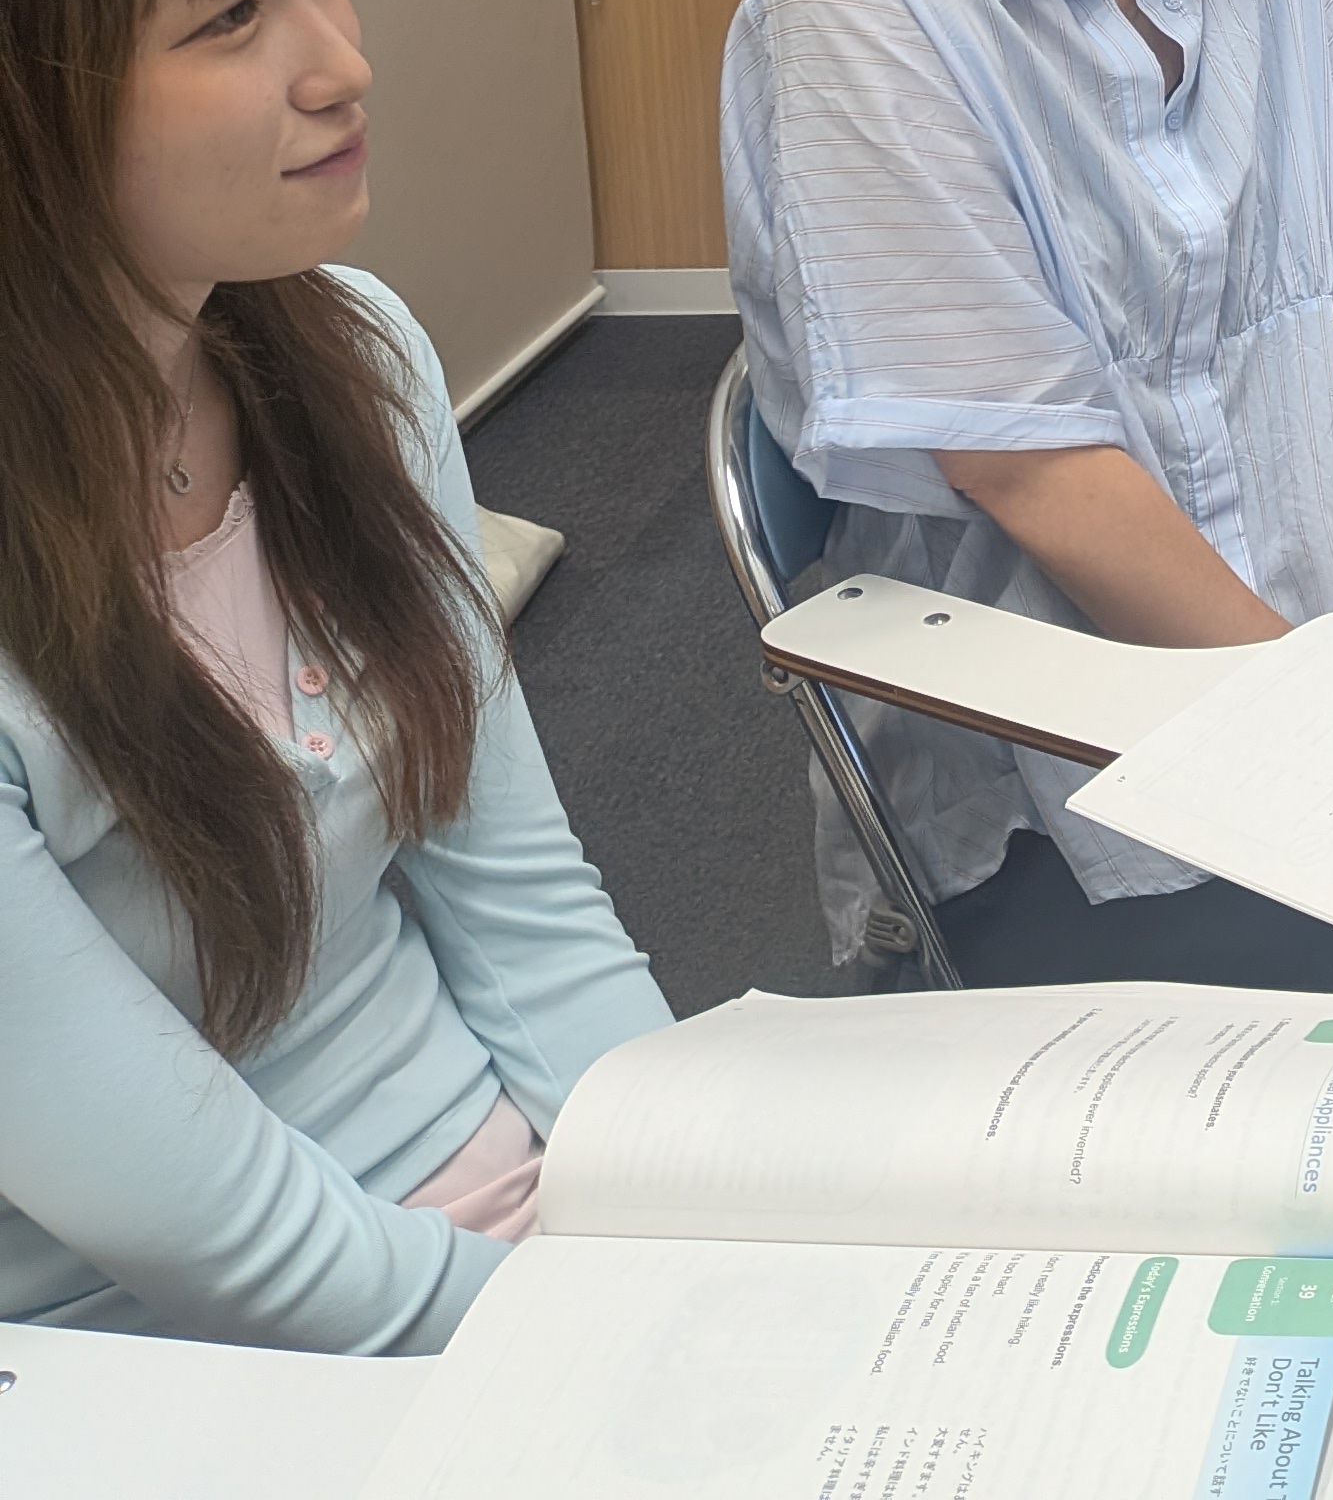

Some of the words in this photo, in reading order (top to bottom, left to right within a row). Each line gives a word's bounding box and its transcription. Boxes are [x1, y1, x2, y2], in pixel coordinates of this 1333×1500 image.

[1092, 1072, 1117, 1101] appliance
[985, 1086, 1015, 1141] appliances.
[1084, 1103, 1099, 1124] ever
[1204, 1082, 1232, 1131] classmates.
[1069, 1126, 1094, 1185] invented?
[919, 1261, 935, 1274] not
[947, 1261, 964, 1273] too
[974, 1262, 990, 1274] not
[1003, 1262, 1019, 1274] too
[1084, 1256, 1110, 1285] Practice
[1141, 1261, 1166, 1293] Today's
[905, 1274, 927, 1297] really
[933, 1274, 955, 1297] spicy
[964, 1283, 981, 1297] fan
[992, 1276, 1013, 1297] hard.
[1028, 1275, 1050, 1298] really
[1078, 1286, 1094, 1301] the
[1245, 1265, 1276, 1322] Conversation
[1299, 1284, 1318, 1299] 39
[897, 1299, 916, 1316] into
[929, 1299, 944, 1310] for
[959, 1299, 971, 1308] of
[1023, 1299, 1041, 1315] like
[882, 1318, 906, 1347] Italian
[919, 1312, 936, 1330] me.
[944, 1310, 968, 1338] Indian
[1007, 1316, 1032, 1348] hiking.
[1118, 1294, 1151, 1353] Expressions
[1050, 1303, 1084, 1370] expressions.
[870, 1349, 892, 1376] food.
[932, 1341, 954, 1367] food.
[1261, 1358, 1292, 1408] Don't
[1281, 1357, 1320, 1423] Talking
[951, 1428, 973, 1454] せん。
[1210, 1357, 1257, 1498] 好きでないことについて話す
[1250, 1413, 1278, 1451] Like
[816, 1425, 842, 1462] ません。
[911, 1427, 949, 1499] 大変すぎます。
[1268, 1427, 1302, 1489] About
